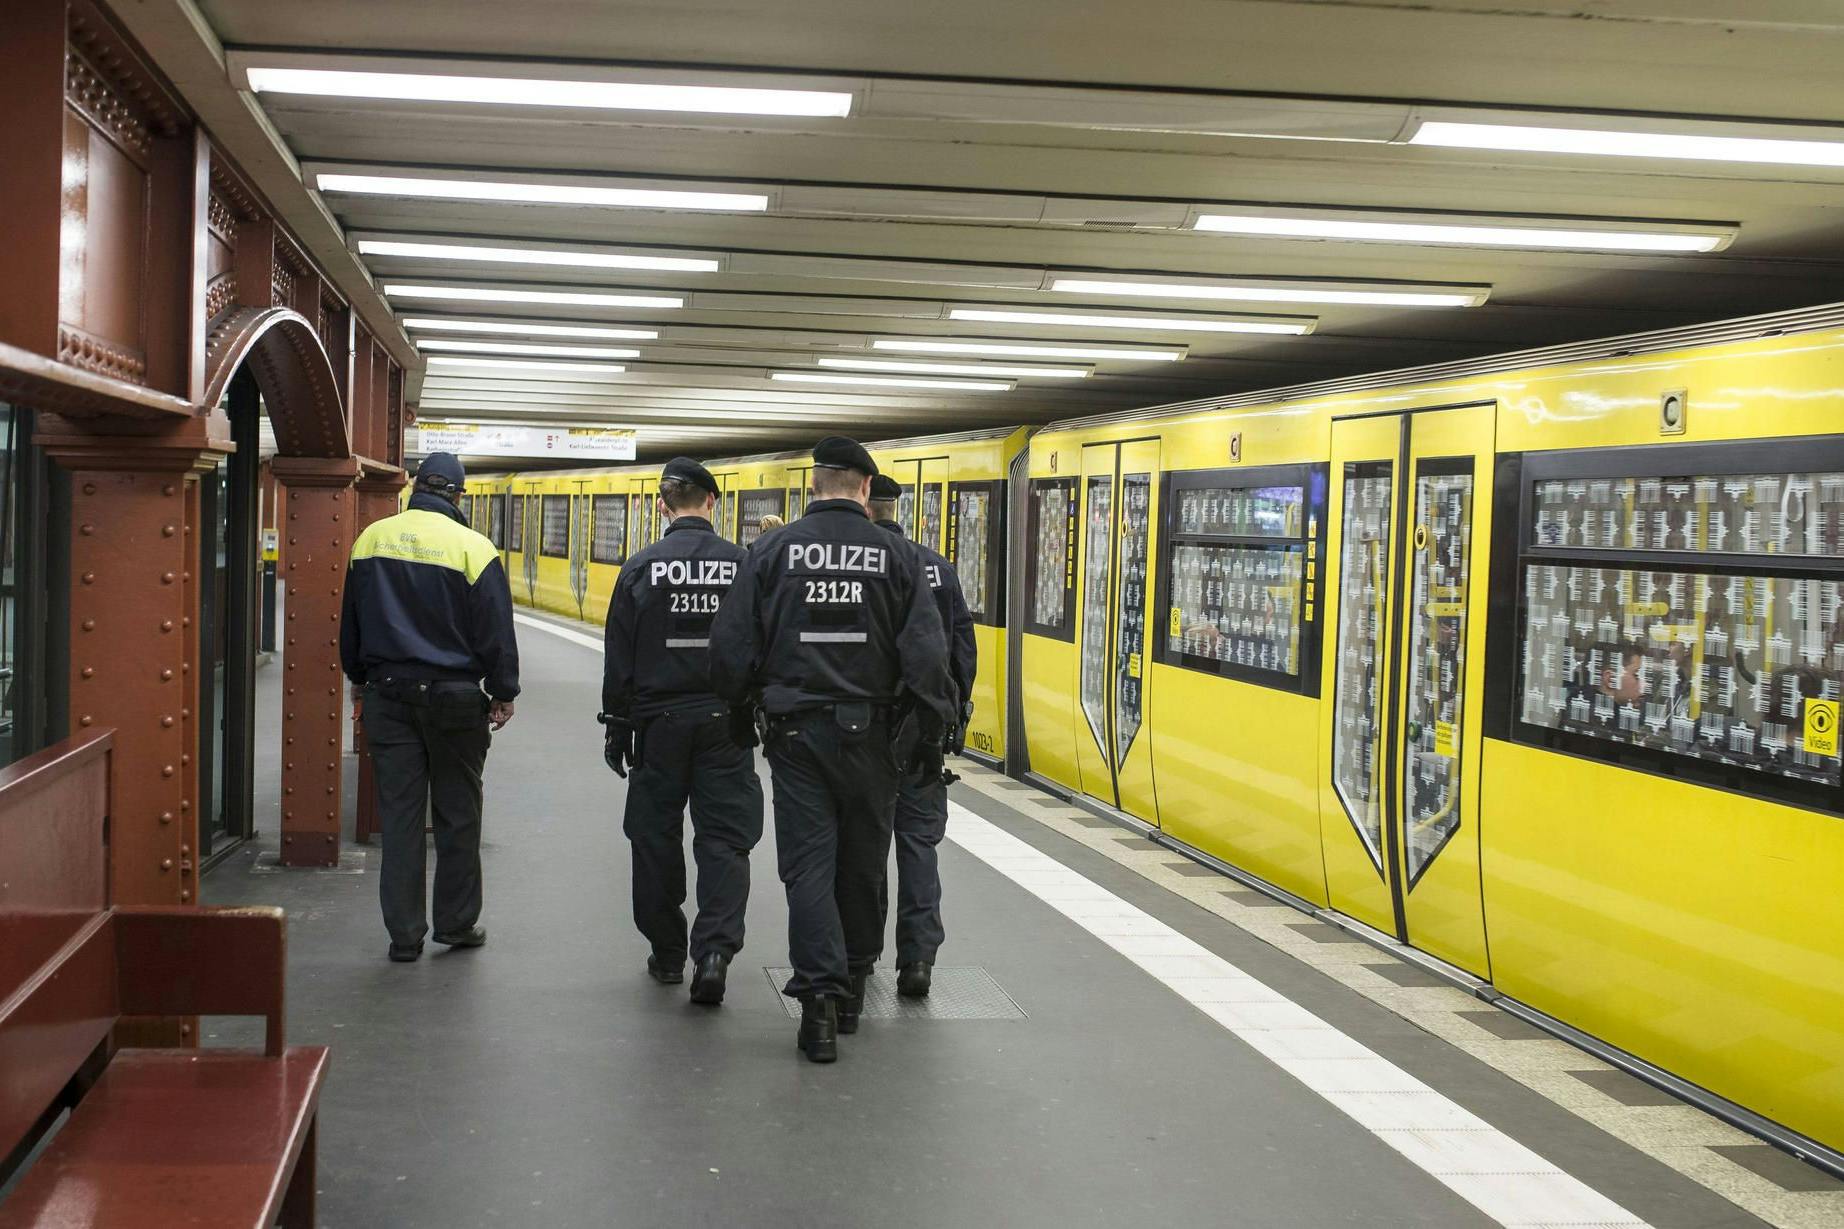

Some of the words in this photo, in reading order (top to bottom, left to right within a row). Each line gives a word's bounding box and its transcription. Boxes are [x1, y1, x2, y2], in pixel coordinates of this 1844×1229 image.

[787, 543, 888, 574] POLIZEI
[670, 592, 720, 613] 23119
[805, 581, 863, 604] 2312R
[1808, 735, 1832, 751] Video
